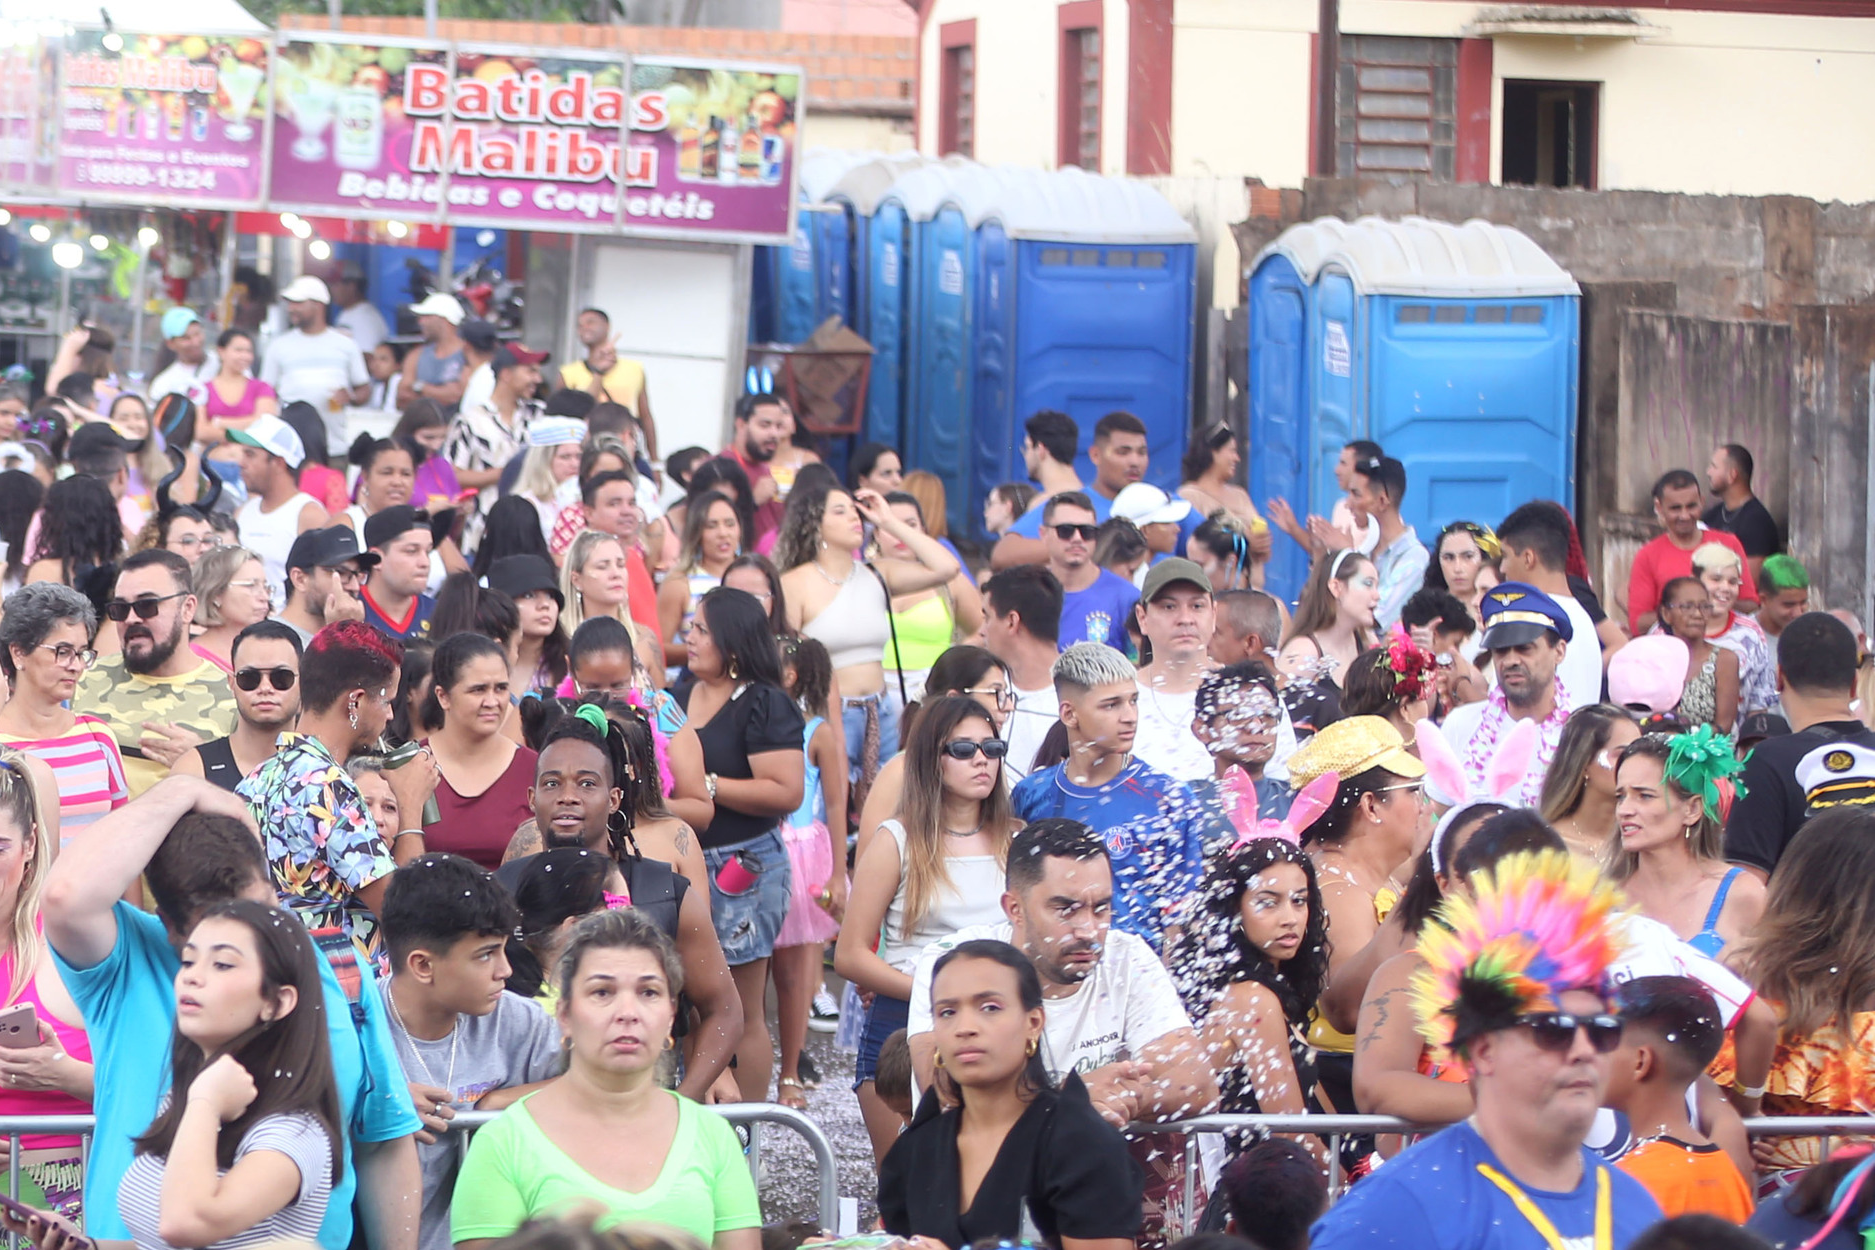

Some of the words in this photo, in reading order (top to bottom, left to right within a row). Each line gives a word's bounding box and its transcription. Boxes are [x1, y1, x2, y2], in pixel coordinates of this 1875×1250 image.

[122, 52, 219, 93] Malibu
[404, 61, 671, 132] Batidas
[410, 120, 661, 189] Malibu
[337, 171, 491, 209] Bebidas
[497, 186, 524, 210] e
[531, 182, 716, 222] Coquetéis
